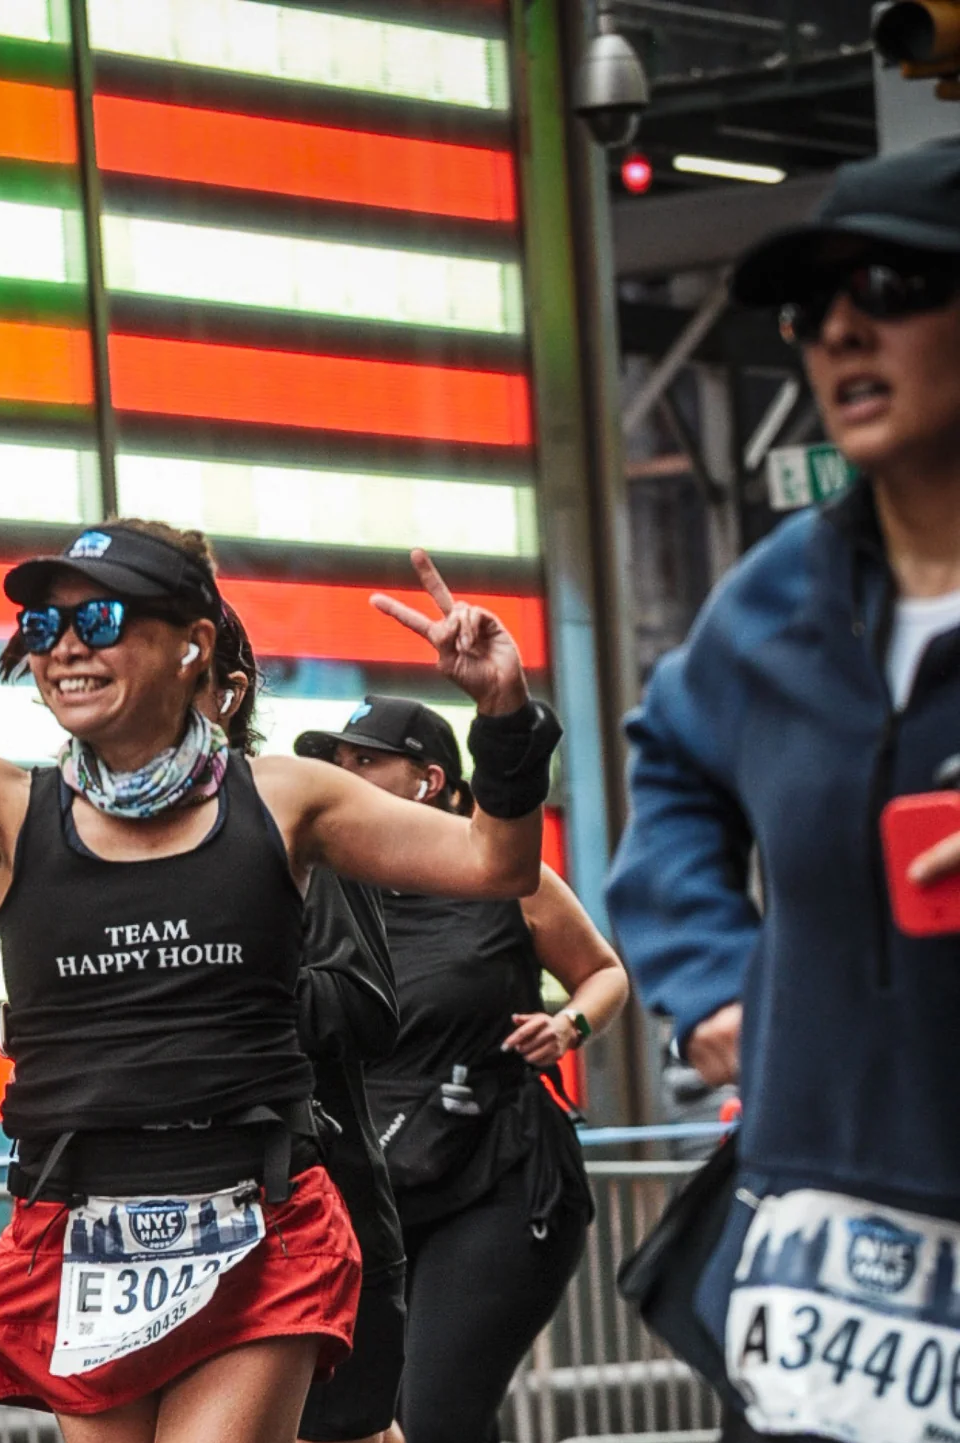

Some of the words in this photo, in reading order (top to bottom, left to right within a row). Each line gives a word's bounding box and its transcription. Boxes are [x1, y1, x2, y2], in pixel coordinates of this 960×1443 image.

[104, 918, 191, 947] TEAM
[56, 949, 150, 977] HAPPY
[157, 943, 244, 969] HOUR
[136, 1211, 179, 1231] NYC
[140, 1228, 176, 1242] HALF
[143, 1300, 188, 1344] 30435
